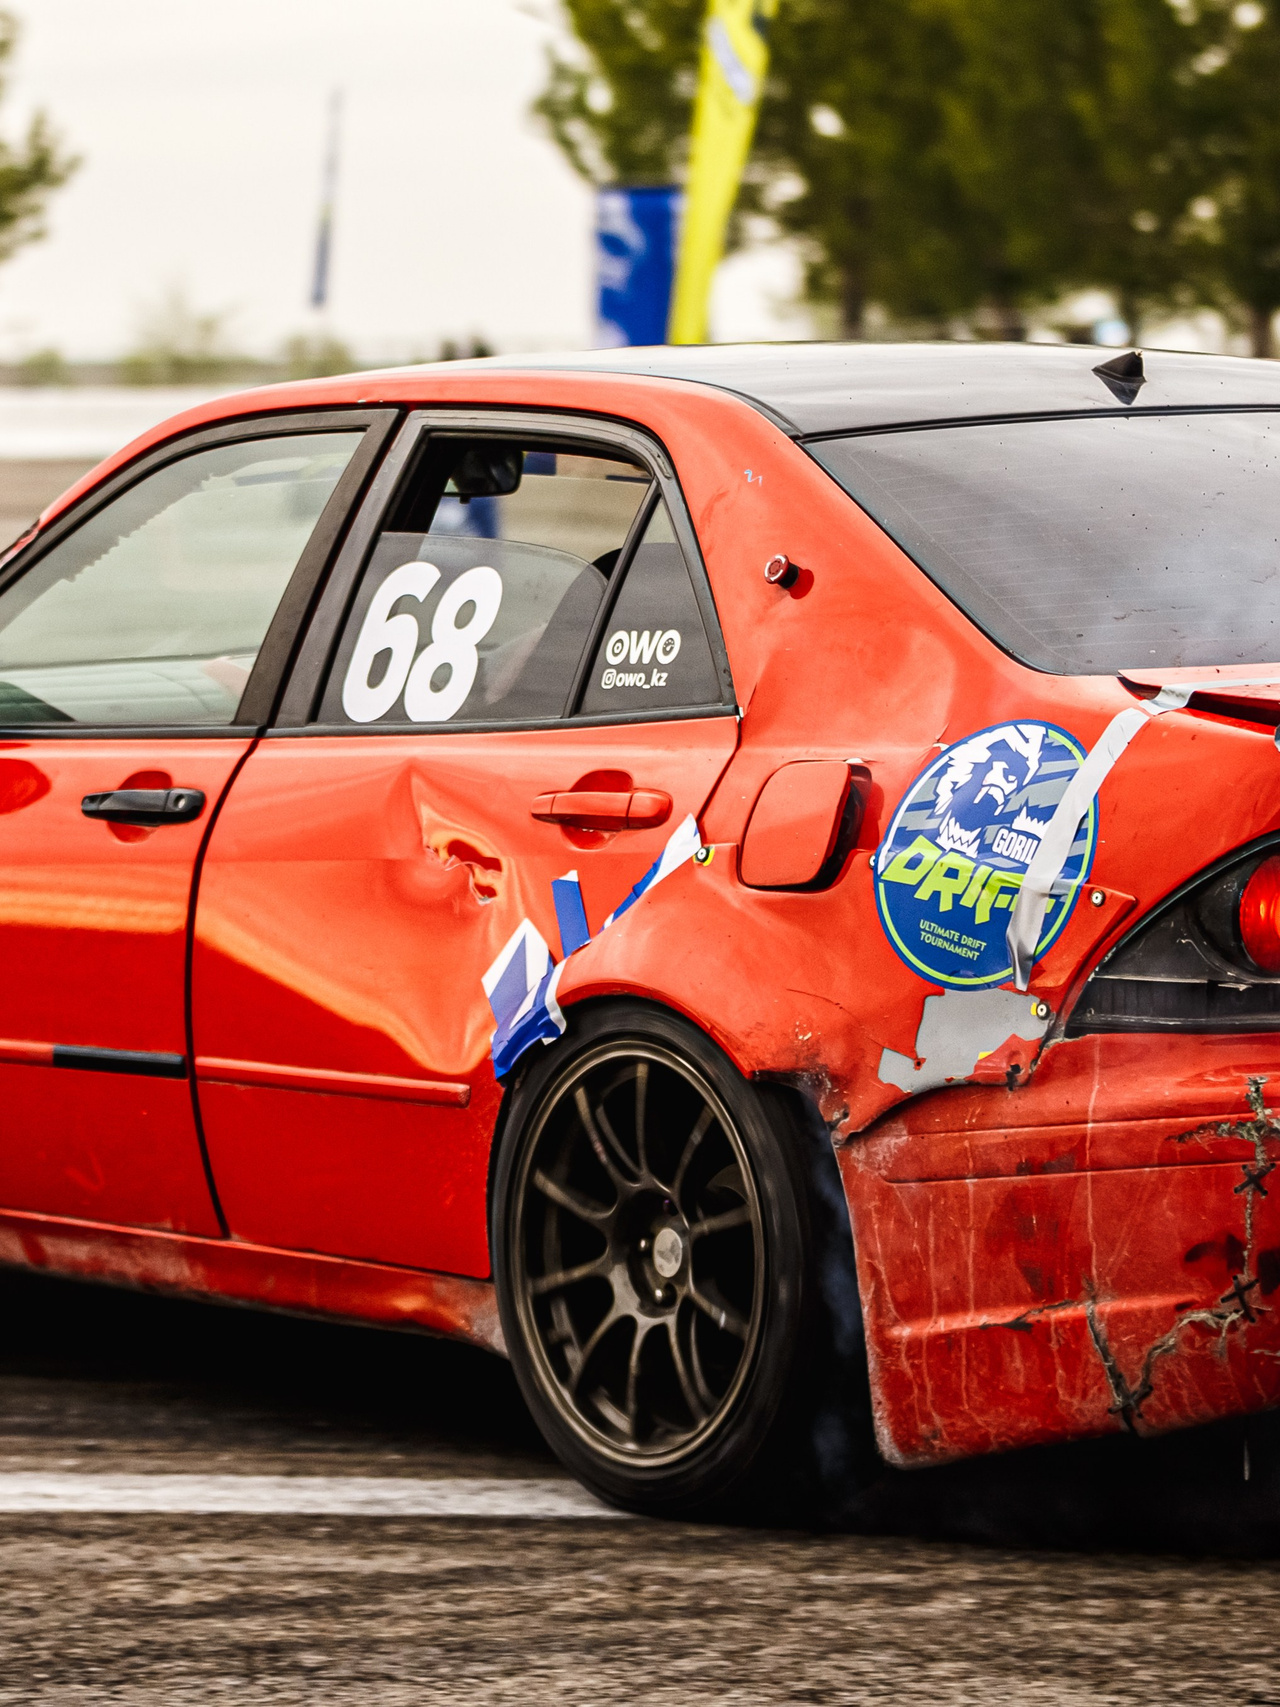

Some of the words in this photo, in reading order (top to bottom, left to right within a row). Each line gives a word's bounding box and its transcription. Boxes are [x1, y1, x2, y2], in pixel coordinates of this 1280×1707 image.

[343, 561, 503, 723] 68
[605, 629, 681, 665] OWO
[992, 828, 1038, 865] GORIL
[919, 919, 960, 942] ULTIMATE
[960, 935, 987, 951] DRIFT
[920, 931, 980, 960] TOURNAMENT
